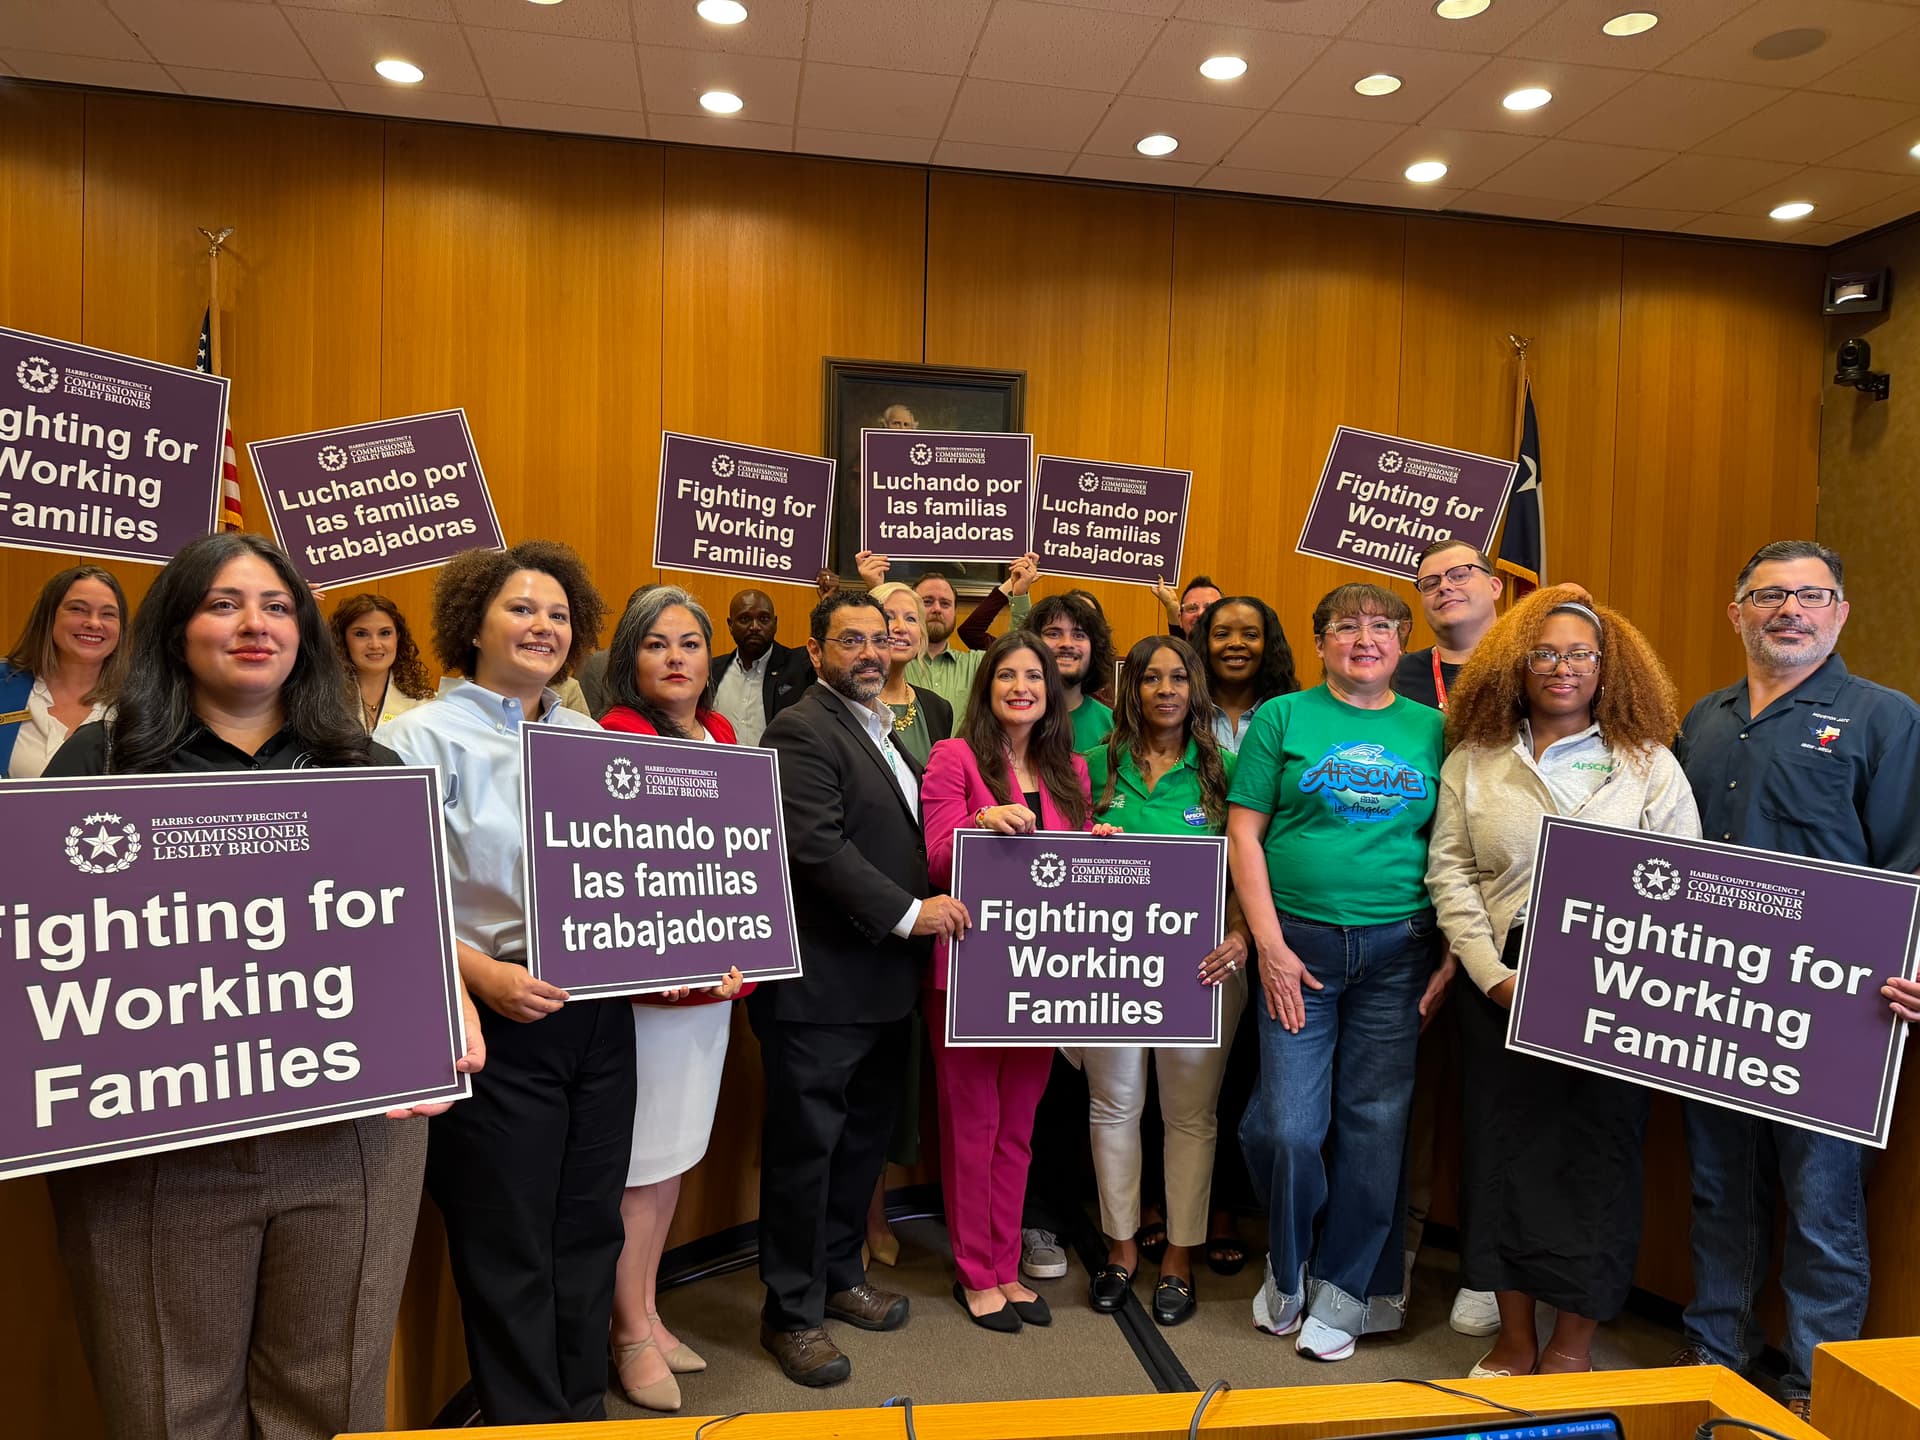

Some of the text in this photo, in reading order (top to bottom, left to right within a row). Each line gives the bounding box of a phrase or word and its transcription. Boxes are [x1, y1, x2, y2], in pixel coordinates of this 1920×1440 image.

[64, 375, 151, 402] COMMISSIONER
[65, 367, 89, 378] HARRIS
[89, 373, 116, 384] COUNTY
[117, 379, 147, 390] PRECINCT
[63, 384, 151, 410] LESLEY BRIONES
[0, 404, 198, 465] ghting for
[350, 440, 415, 457] COMMISSIONER
[352, 447, 416, 463] LESLEY BRIONES
[1405, 462, 1459, 478] COMMISSIONER
[0, 446, 162, 508] Working
[278, 460, 469, 511] Luchando por
[737, 464, 788, 478] COMMISSIONER
[737, 470, 788, 484] LESLEY BRIONES
[873, 471, 1023, 497] Luchando por
[1101, 480, 1147, 490] COMMISSIONER
[1403, 467, 1457, 484] LESLEY BRIONES
[677, 478, 816, 518] Fighting for
[1100, 485, 1147, 496] LESLEY BRIONES
[1336, 471, 1484, 522] Fighting for
[305, 490, 460, 535] las familias
[887, 496, 1007, 517] las familias
[1042, 494, 1178, 526] Luchando por
[695, 510, 794, 548] Working
[879, 521, 1014, 544] trabajadoras
[1052, 517, 1161, 545] las familias
[1348, 502, 1452, 544] Working
[305, 517, 477, 566] trabajadoras
[693, 538, 792, 570] Families
[1043, 539, 1165, 568] trabajadoras
[1336, 529, 1422, 569] Familie
[644, 765, 664, 773] HARRIS
[665, 766, 688, 774] COUNTY
[688, 768, 713, 777] PRECINCT
[645, 774, 718, 789] COMMISSIONER
[1303, 759, 1422, 793] AFSCME
[646, 784, 719, 799] LESLEY BRIONES
[151, 811, 308, 827] HARRIS COUNTY PRECINCT 4
[1352, 801, 1392, 818] Angeles
[152, 824, 309, 845] COMMISSIONER
[153, 838, 310, 861] LESLEY BRIONES
[544, 811, 772, 859] Luchando por
[573, 862, 758, 899] las familias
[1071, 865, 1150, 876] COMMISSIONER
[1071, 874, 1151, 885] LESLEY BRIONES
[1689, 869, 1719, 881] HARRIS
[1720, 875, 1756, 888] COUNTY
[1756, 882, 1800, 896] PRECINCT
[1686, 890, 1803, 921] LESLEY BRIONES
[1688, 879, 1803, 910] COMMISSIONER
[0, 879, 405, 972] ighting for
[562, 909, 772, 955] trabajadoras
[979, 899, 1199, 942] Fighting for
[1561, 897, 1873, 996] Fighting for
[1008, 945, 1165, 987] Working
[26, 962, 354, 1041] Working
[1007, 991, 1164, 1025] Families
[1593, 956, 1812, 1050] Working
[1583, 1007, 1801, 1096] Families
[35, 1038, 361, 1128] Families
